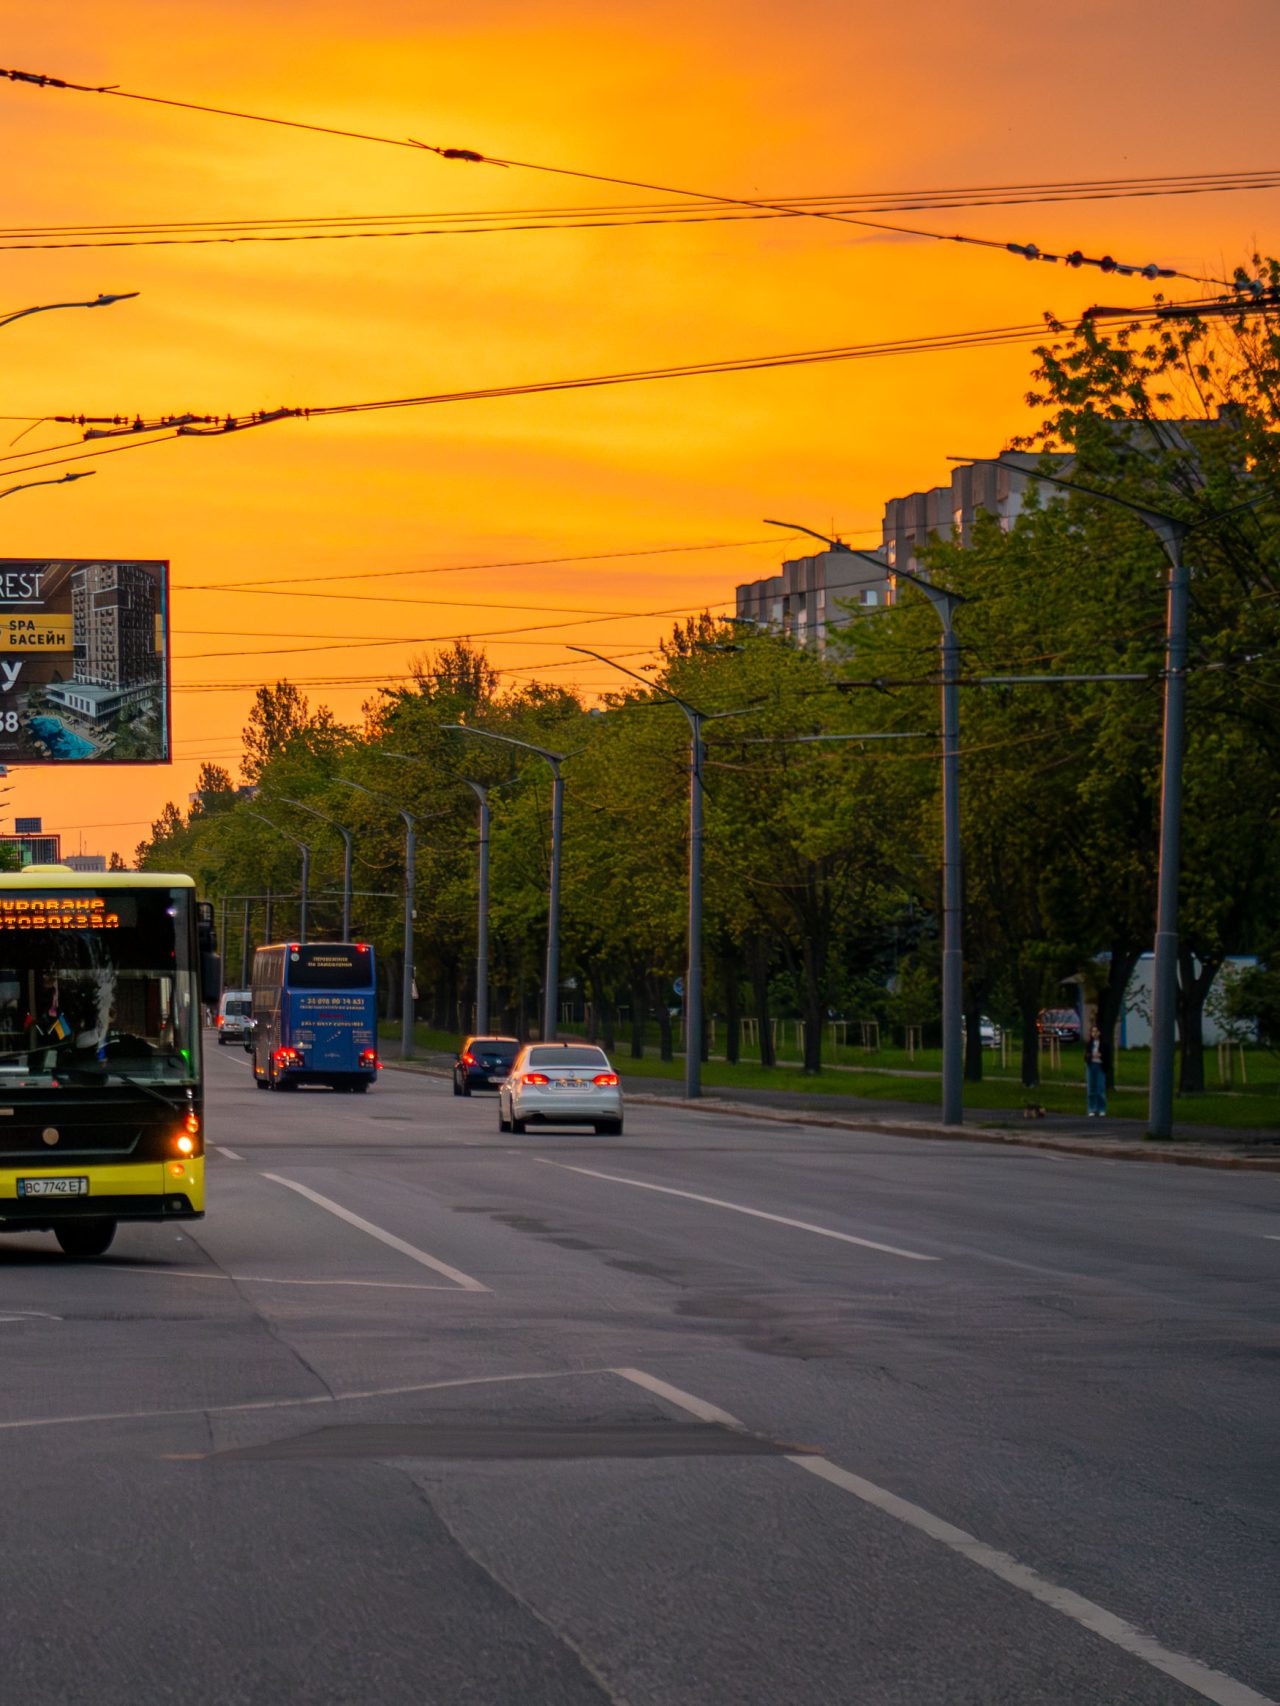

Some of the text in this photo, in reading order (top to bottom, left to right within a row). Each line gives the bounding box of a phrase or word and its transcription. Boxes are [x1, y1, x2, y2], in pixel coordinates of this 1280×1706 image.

[10, 620, 35, 631] SPA
[10, 631, 65, 645] БАСЕЙН
[25, 1182, 40, 1194] BC
[43, 1181, 67, 1193] 7742
